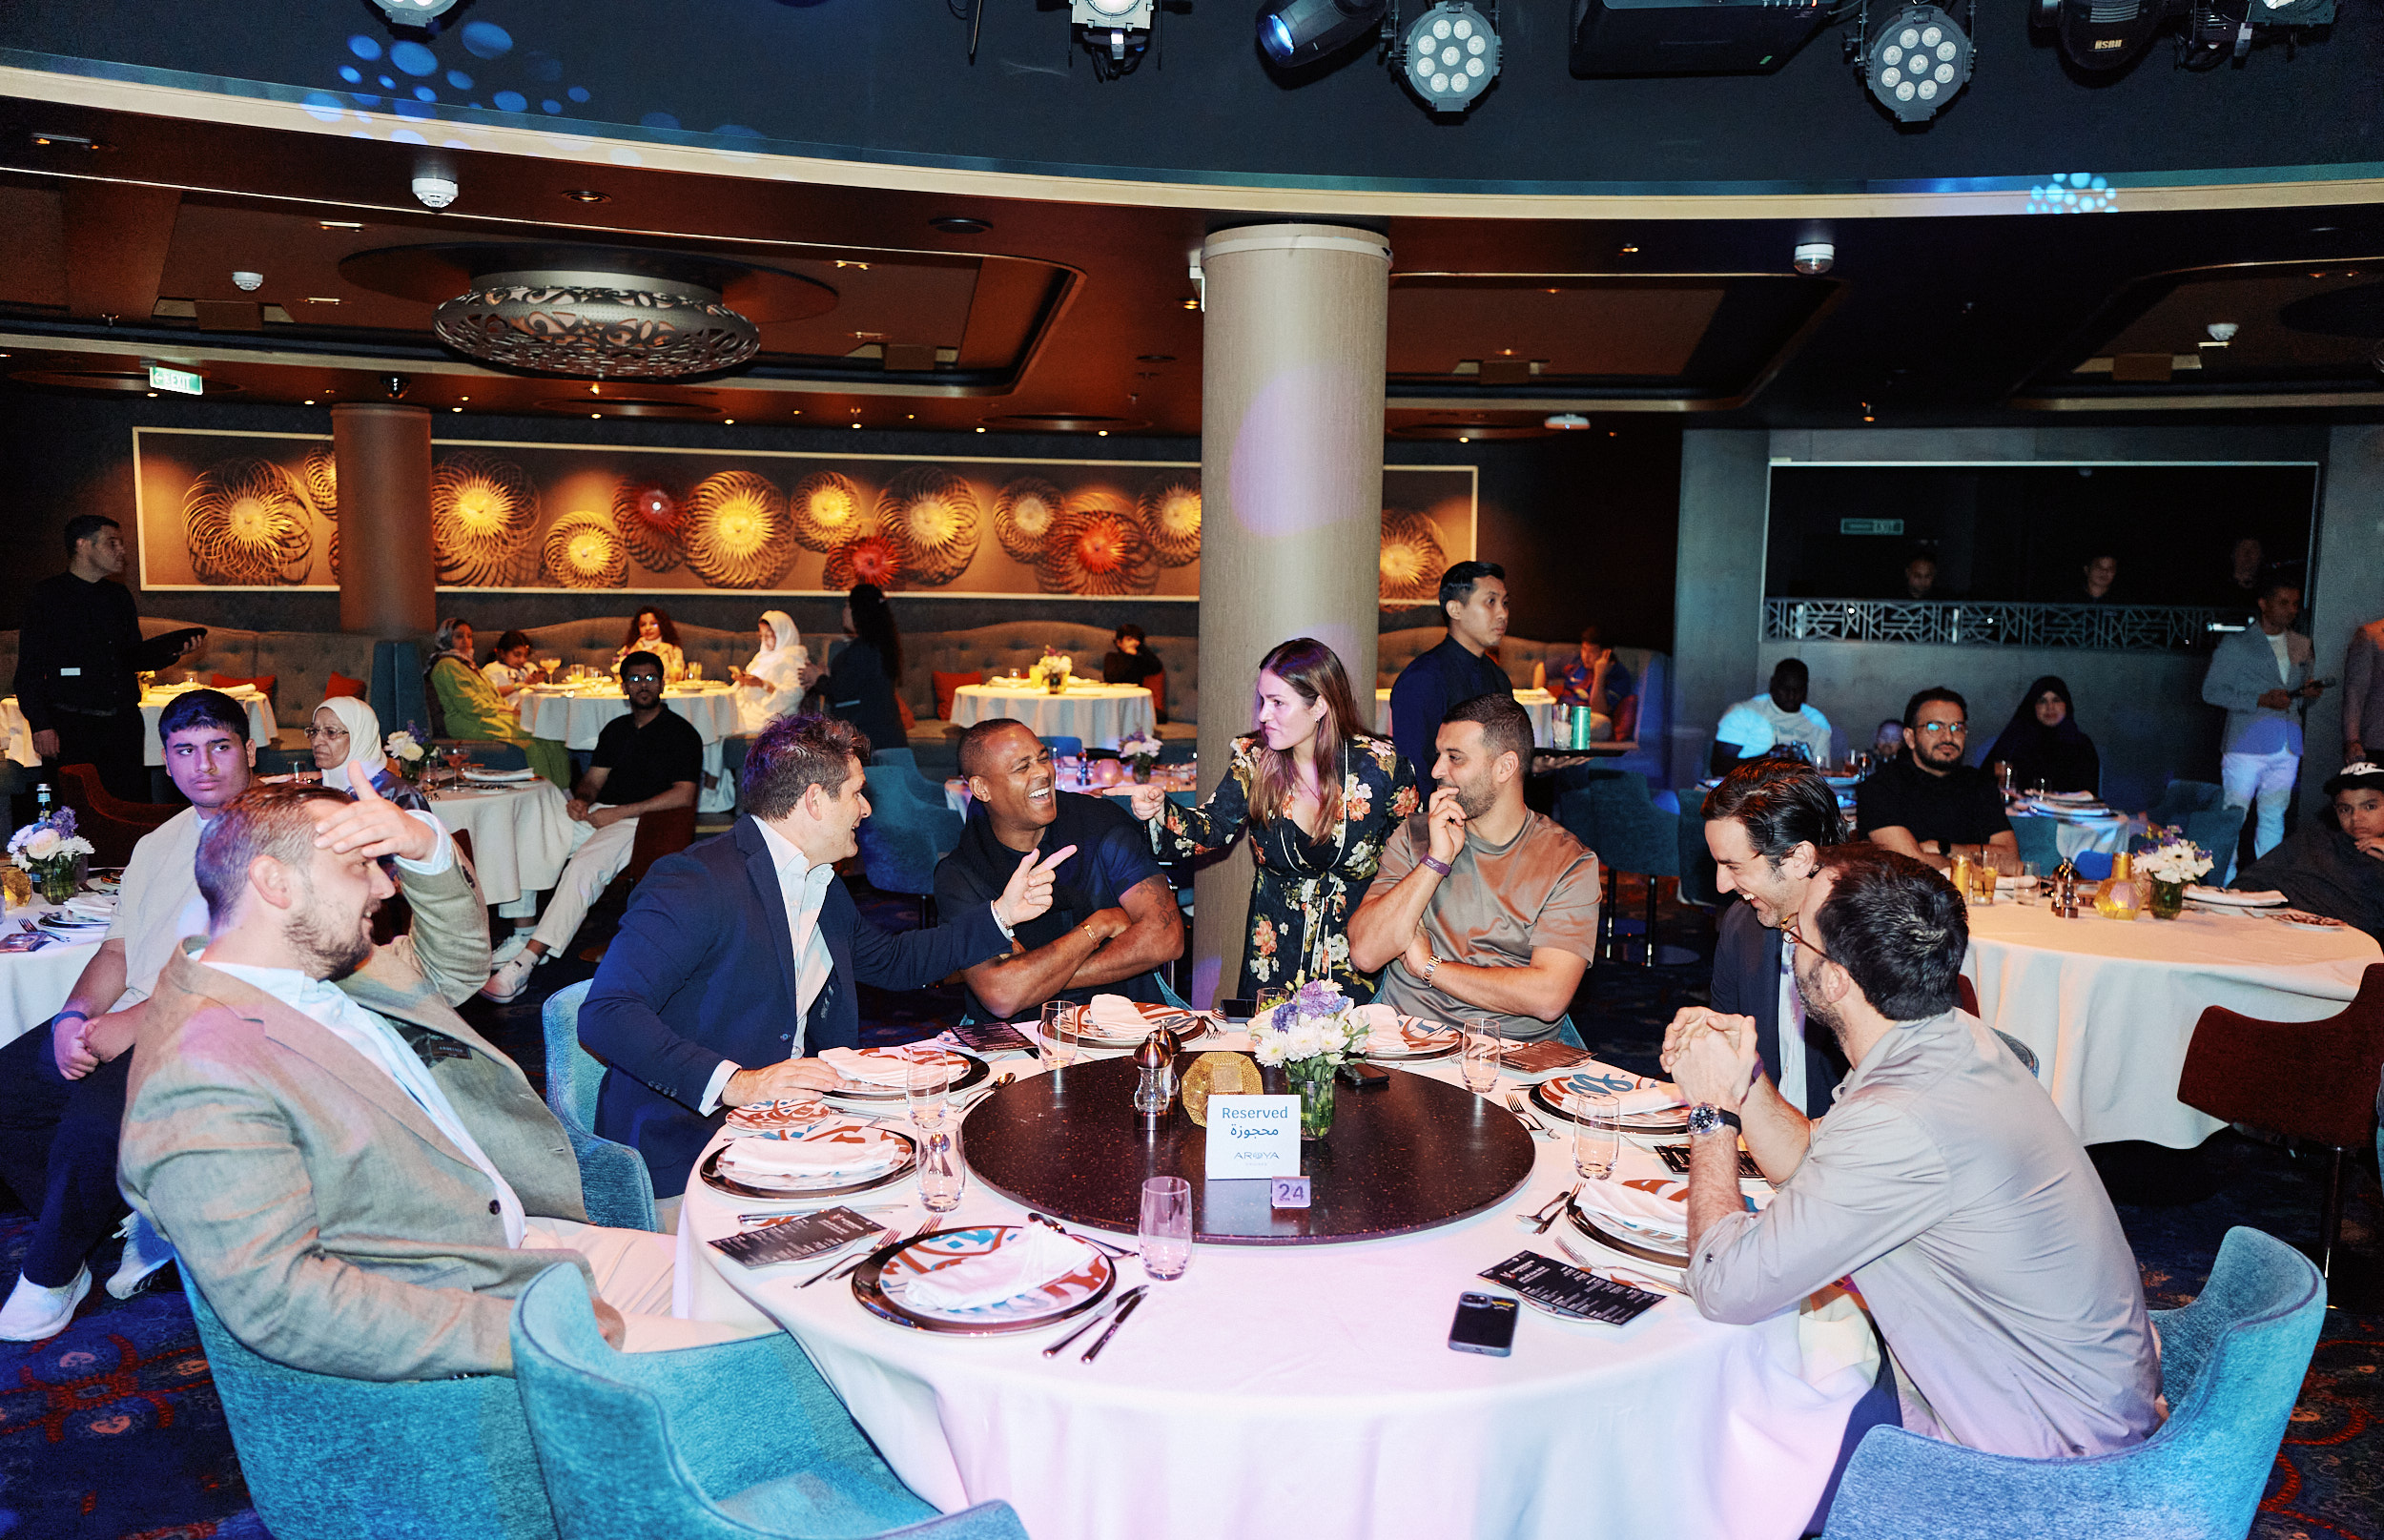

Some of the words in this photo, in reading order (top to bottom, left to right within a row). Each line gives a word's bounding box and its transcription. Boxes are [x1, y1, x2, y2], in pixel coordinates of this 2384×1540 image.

[171, 373, 192, 390] EXIT
[1222, 1106, 1288, 1119] Reserved
[1230, 1123, 1279, 1139] محجوزة
[1234, 1151, 1280, 1160] AROYA
[1279, 1183, 1305, 1201] 24
